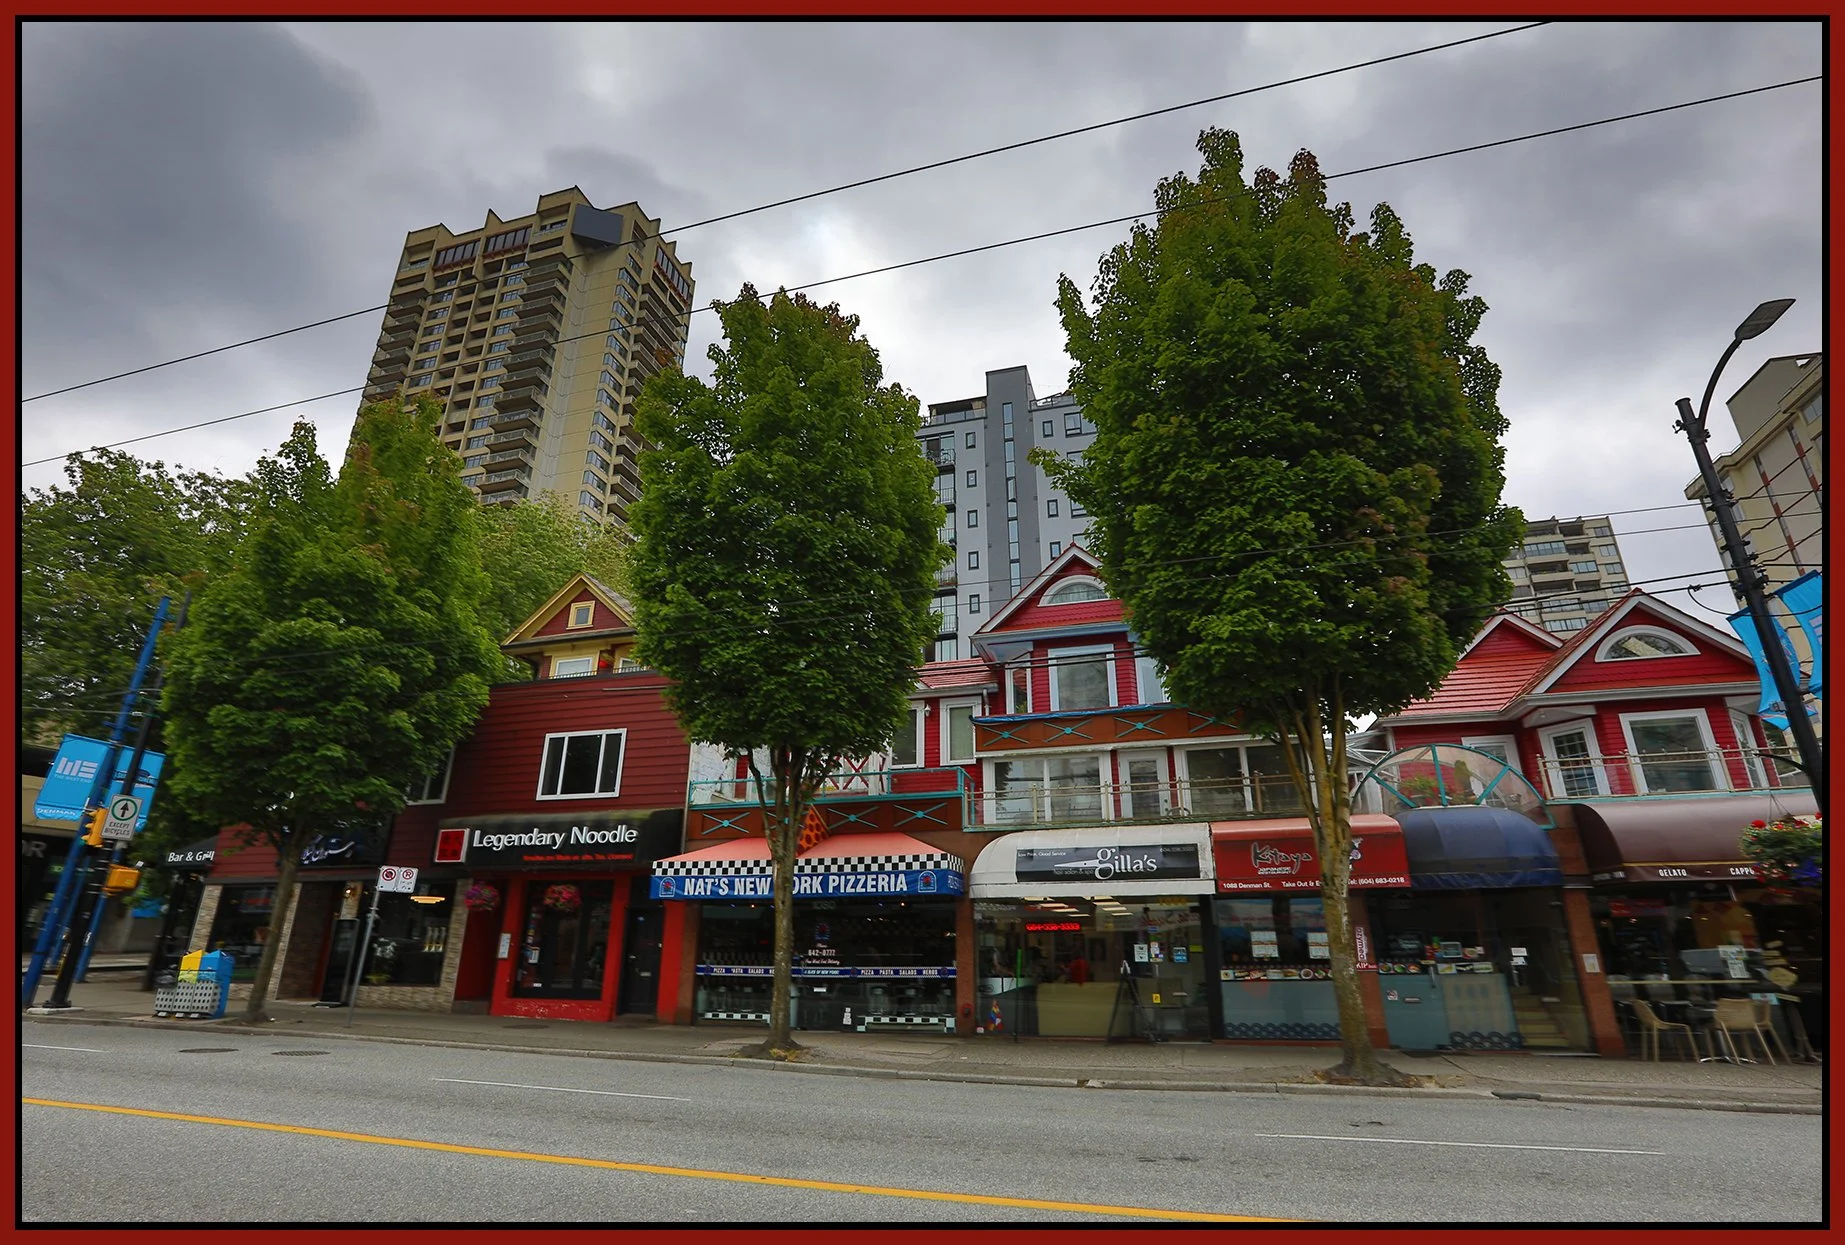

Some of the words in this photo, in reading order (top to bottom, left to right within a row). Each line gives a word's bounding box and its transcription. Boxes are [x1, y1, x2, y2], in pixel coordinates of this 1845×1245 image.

[108, 821, 130, 829] EXCEPT
[104, 827, 130, 836] BICYCLES
[473, 827, 566, 851] Legendary
[570, 824, 639, 845] Noodle
[168, 852, 183, 862] Bar
[186, 852, 194, 861] &
[1094, 848, 1157, 880] gilla's
[1659, 869, 1688, 877] GELATO
[683, 877, 730, 896] NAT'S
[733, 877, 772, 896] NEW
[791, 875, 824, 895] ORK
[828, 873, 908, 893] PIZZERIA
[1375, 876, 1405, 884] 683-0218
